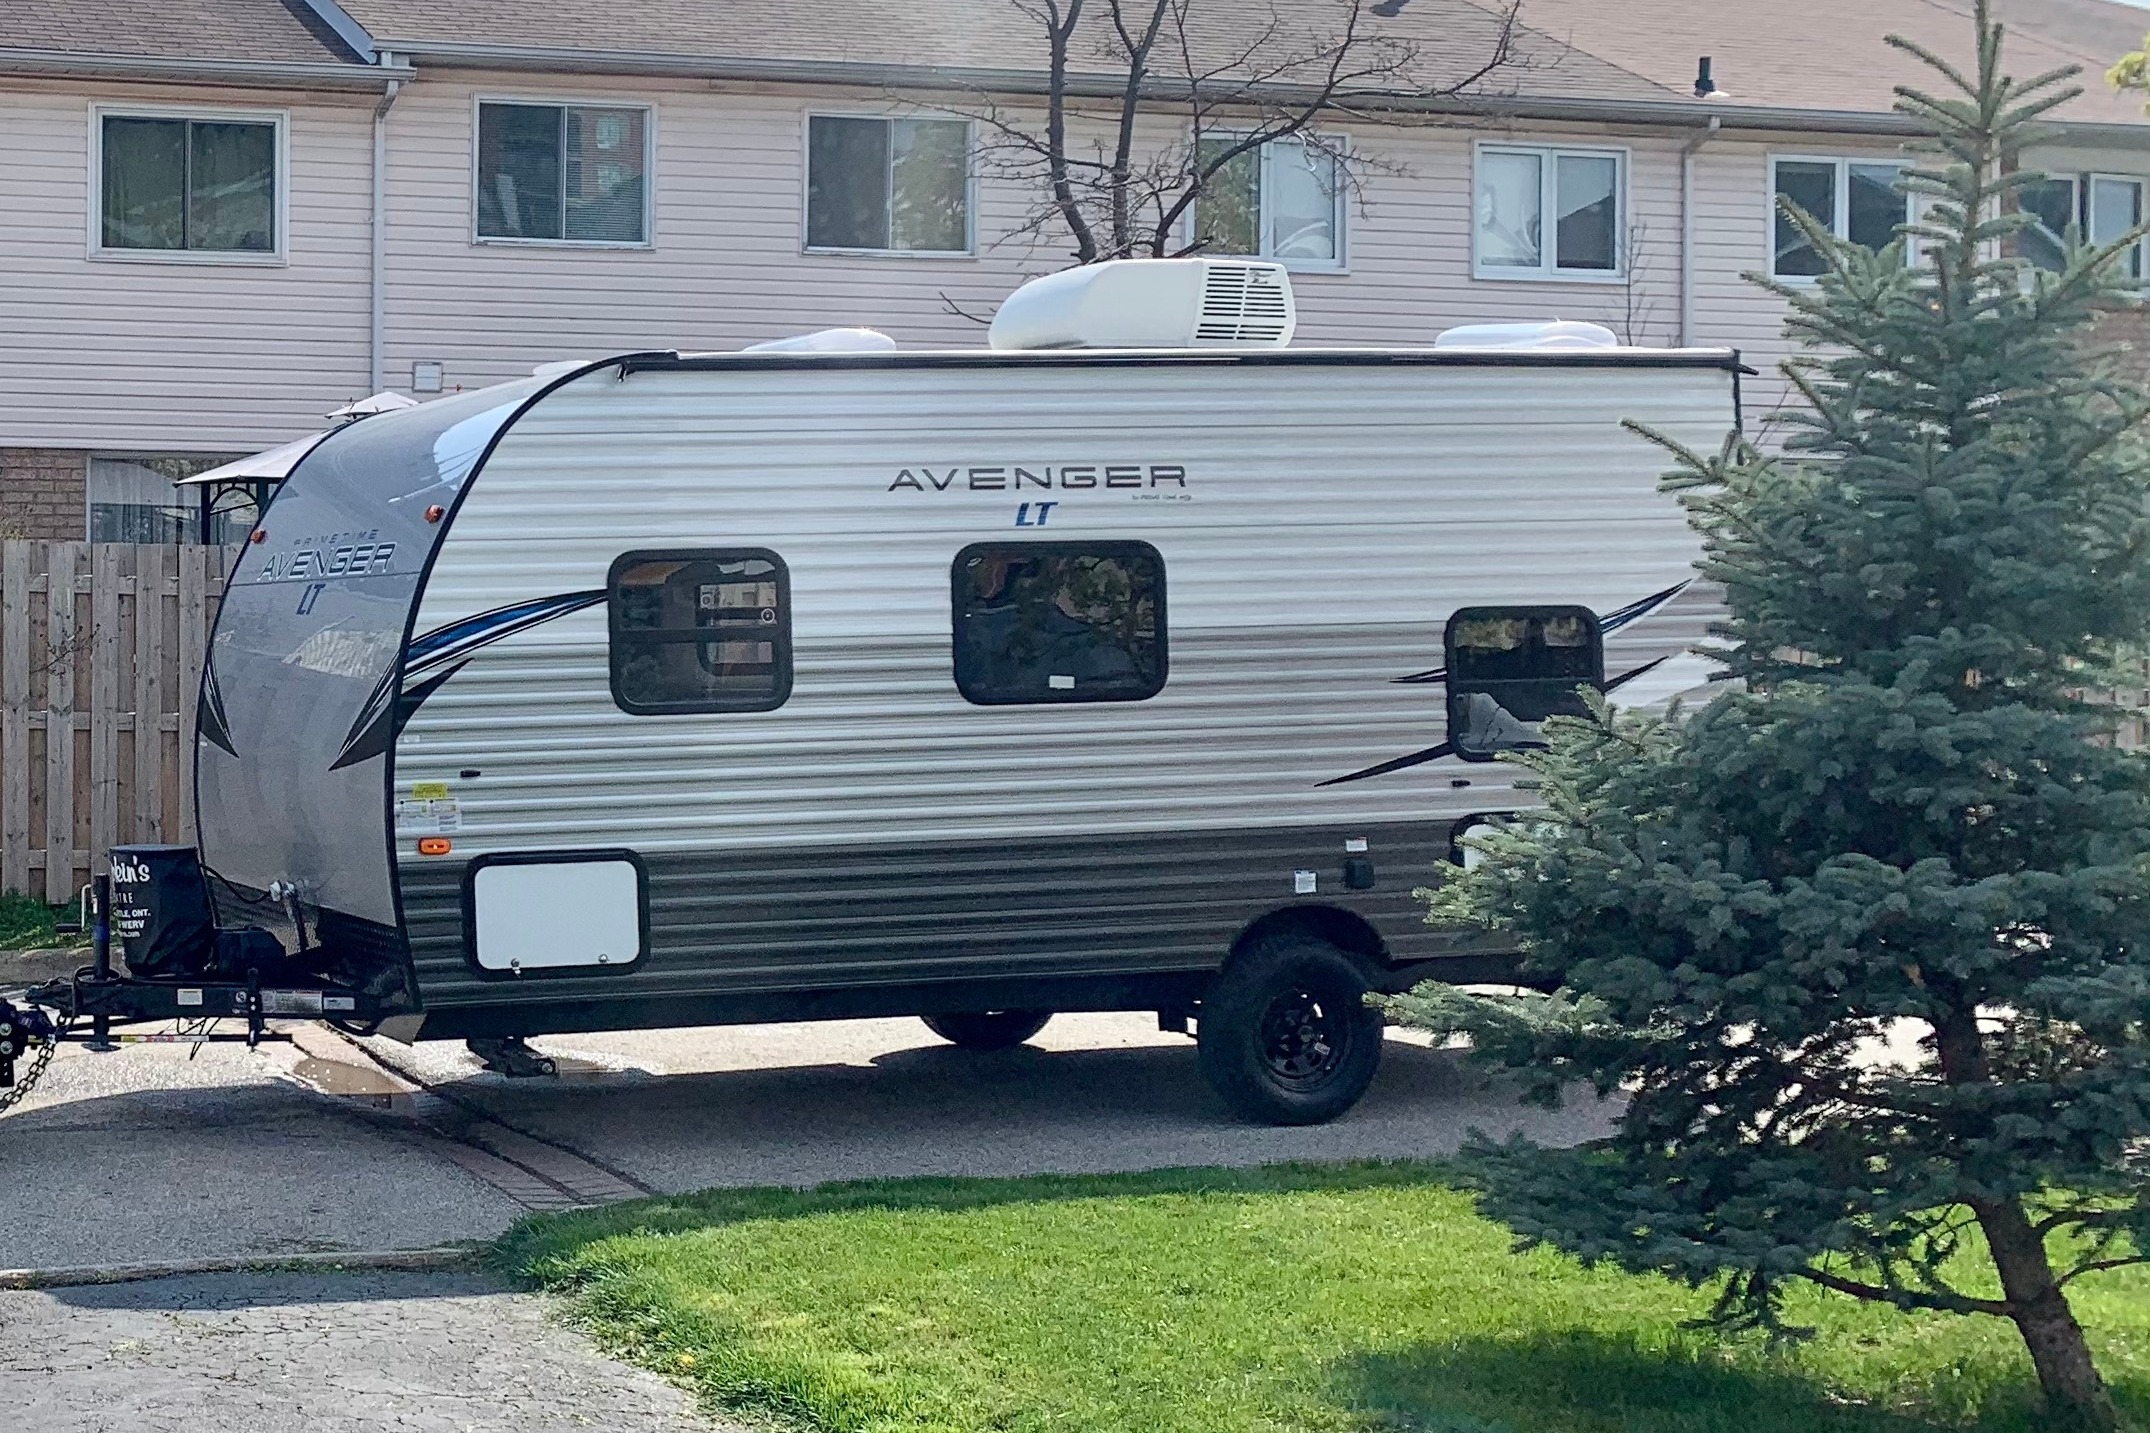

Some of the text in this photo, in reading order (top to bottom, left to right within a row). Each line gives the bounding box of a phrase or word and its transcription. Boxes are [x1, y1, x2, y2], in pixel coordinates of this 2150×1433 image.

[888, 465, 1187, 492] AVENGER
[1015, 501, 1058, 526] LT
[256, 541, 397, 581] AVENGER
[296, 583, 326, 615] LT
